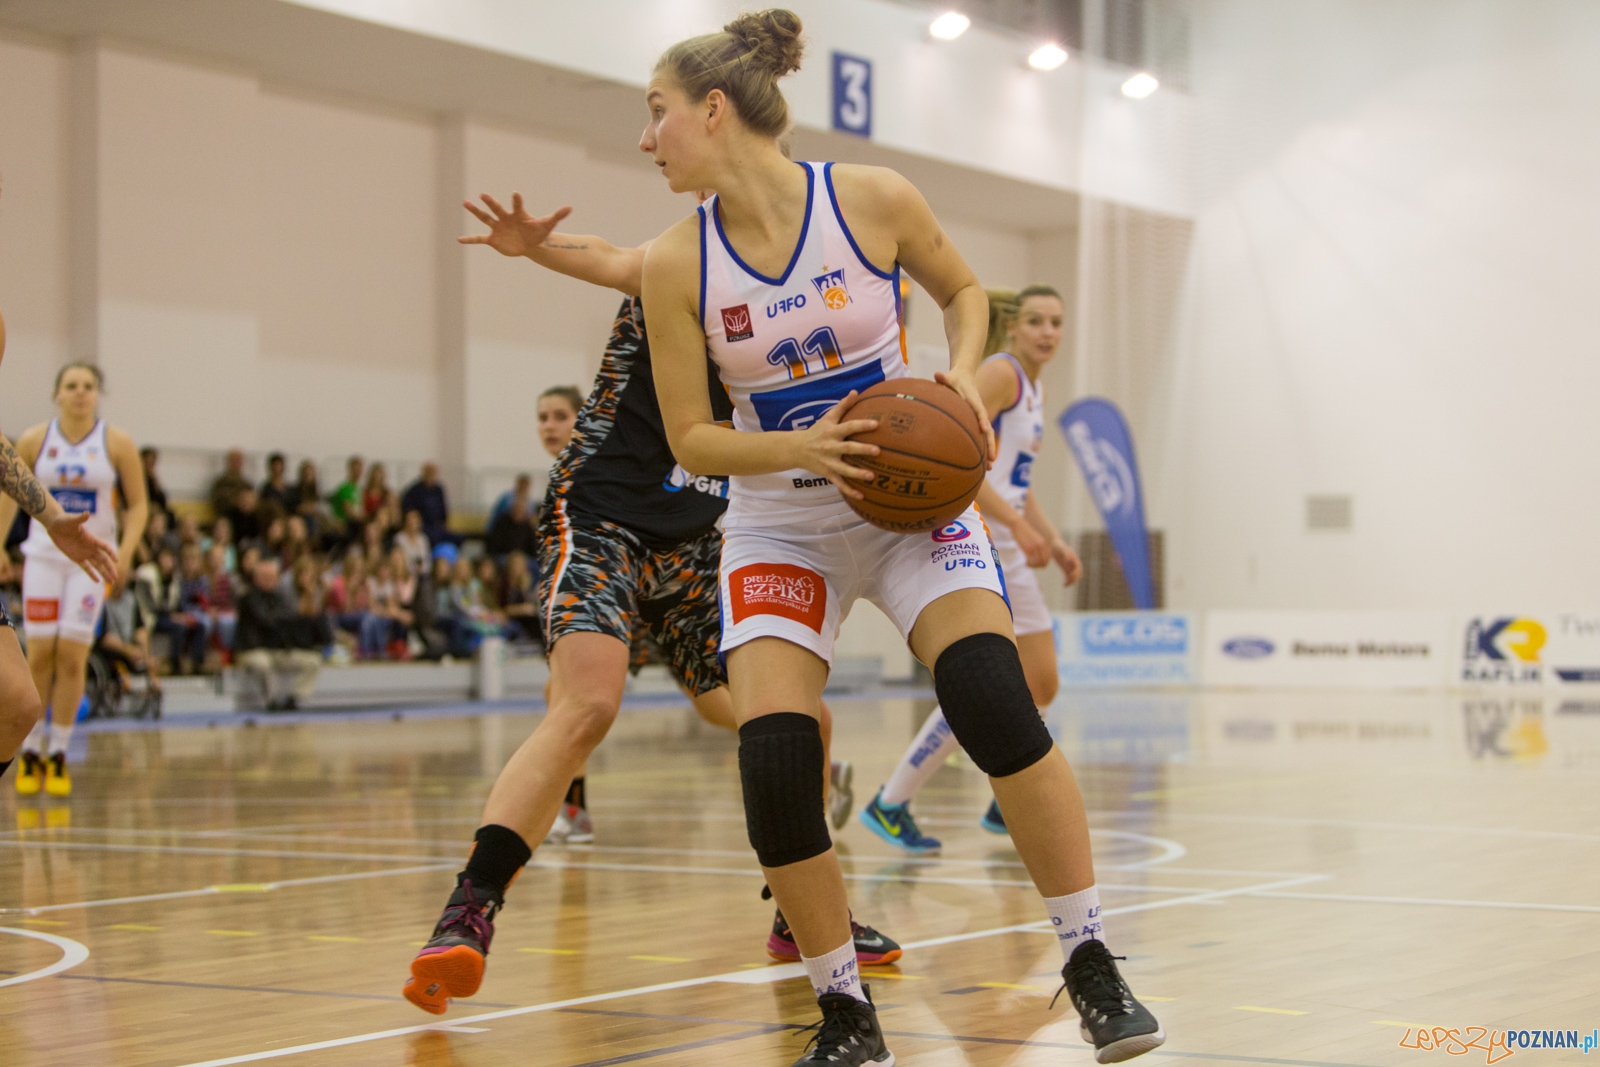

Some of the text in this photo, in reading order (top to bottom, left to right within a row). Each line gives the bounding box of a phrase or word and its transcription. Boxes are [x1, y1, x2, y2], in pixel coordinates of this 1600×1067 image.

[840, 59, 868, 128] 3
[766, 326, 845, 380] 11
[931, 543, 980, 559] POZNAŃ
[932, 549, 981, 564] CITY CENTER
[743, 573, 804, 589] DRUŻYNA
[743, 583, 815, 605] SZPIKU
[826, 978, 850, 994] AZS
